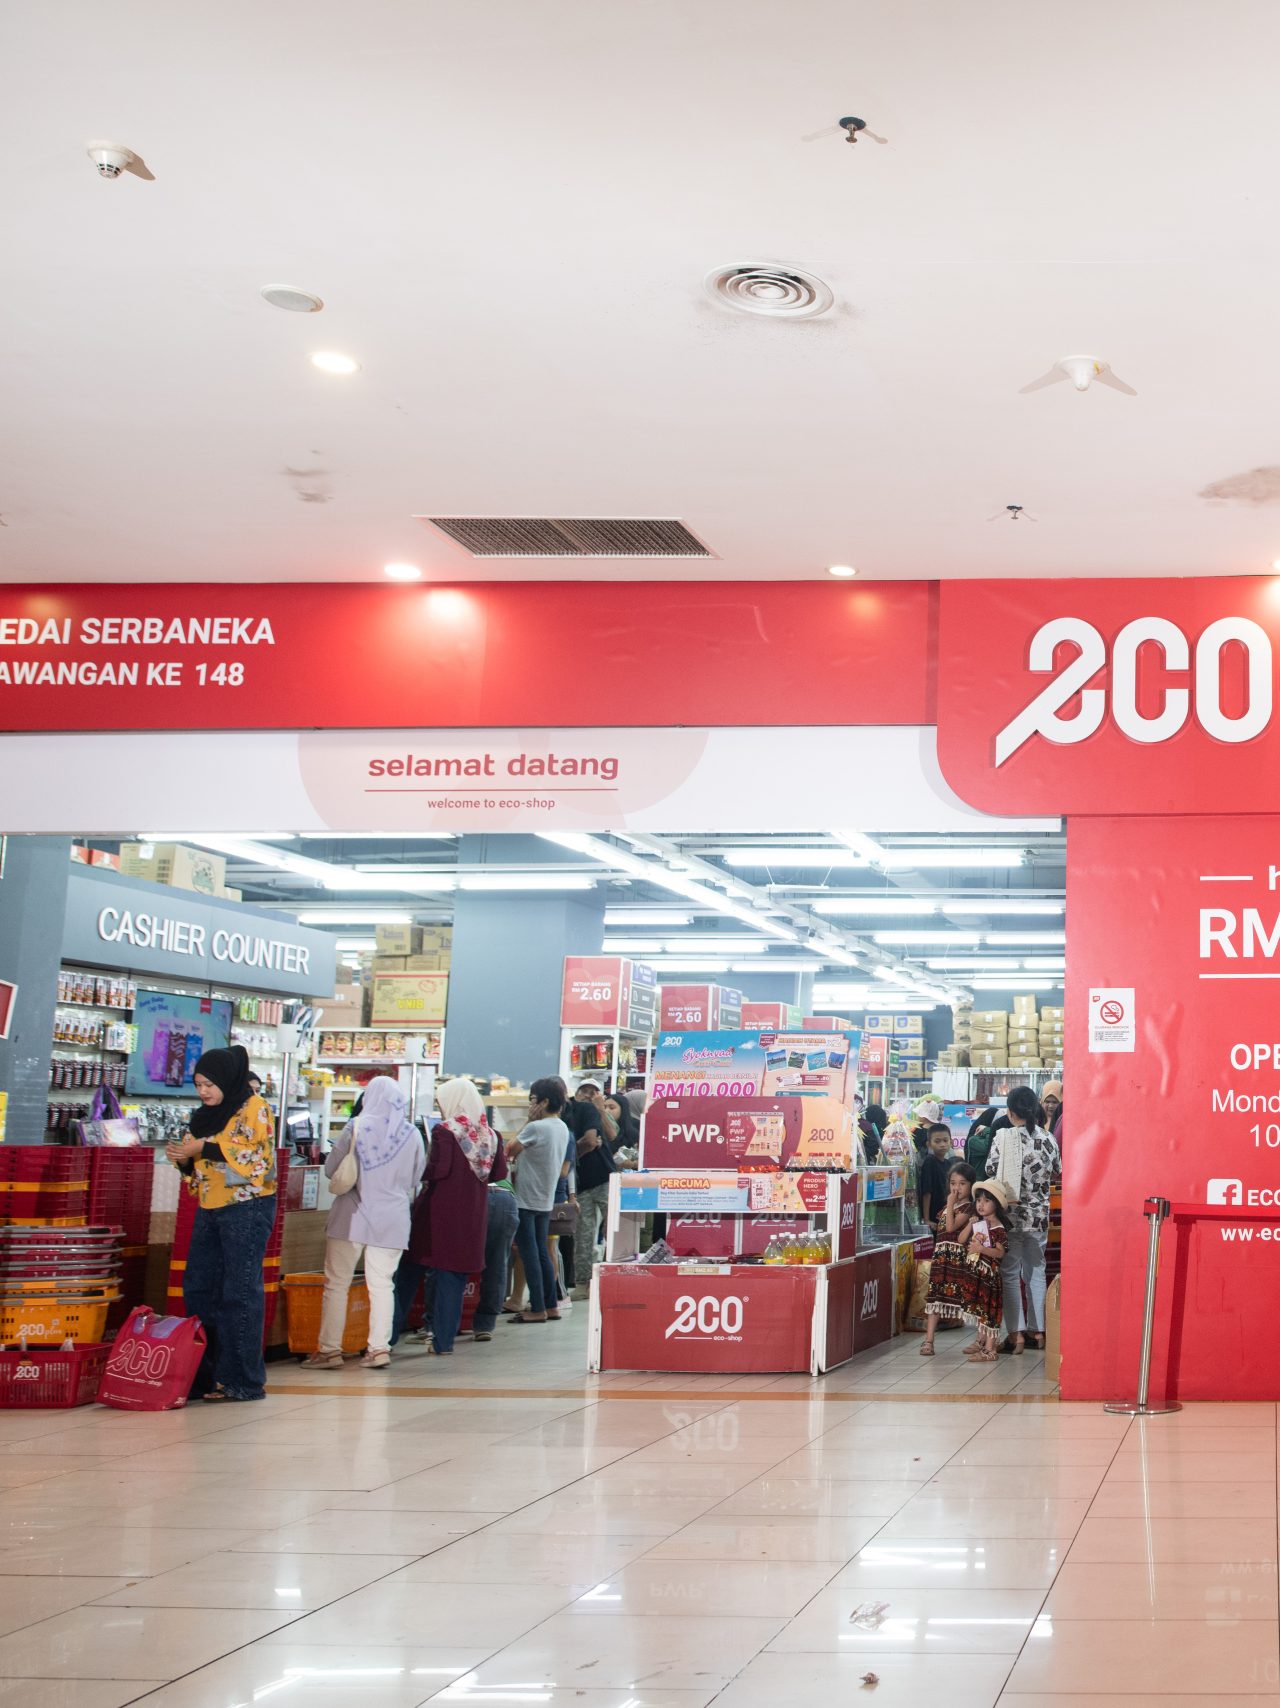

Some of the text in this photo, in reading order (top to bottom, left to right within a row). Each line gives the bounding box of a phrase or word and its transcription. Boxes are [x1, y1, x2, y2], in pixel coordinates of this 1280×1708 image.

[80, 618, 275, 644] SERBANEKA
[0, 662, 245, 686] AWANGAN KE 148
[368, 754, 619, 780] selamat datang
[427, 798, 555, 810] welcome to eco-shop
[98, 906, 310, 975] CASHIER COUNTER
[580, 987, 611, 1000] 2.60
[675, 1012, 702, 1023] 2.60
[668, 1124, 720, 1143] PWP
[661, 1178, 711, 1189] PERCUMA
